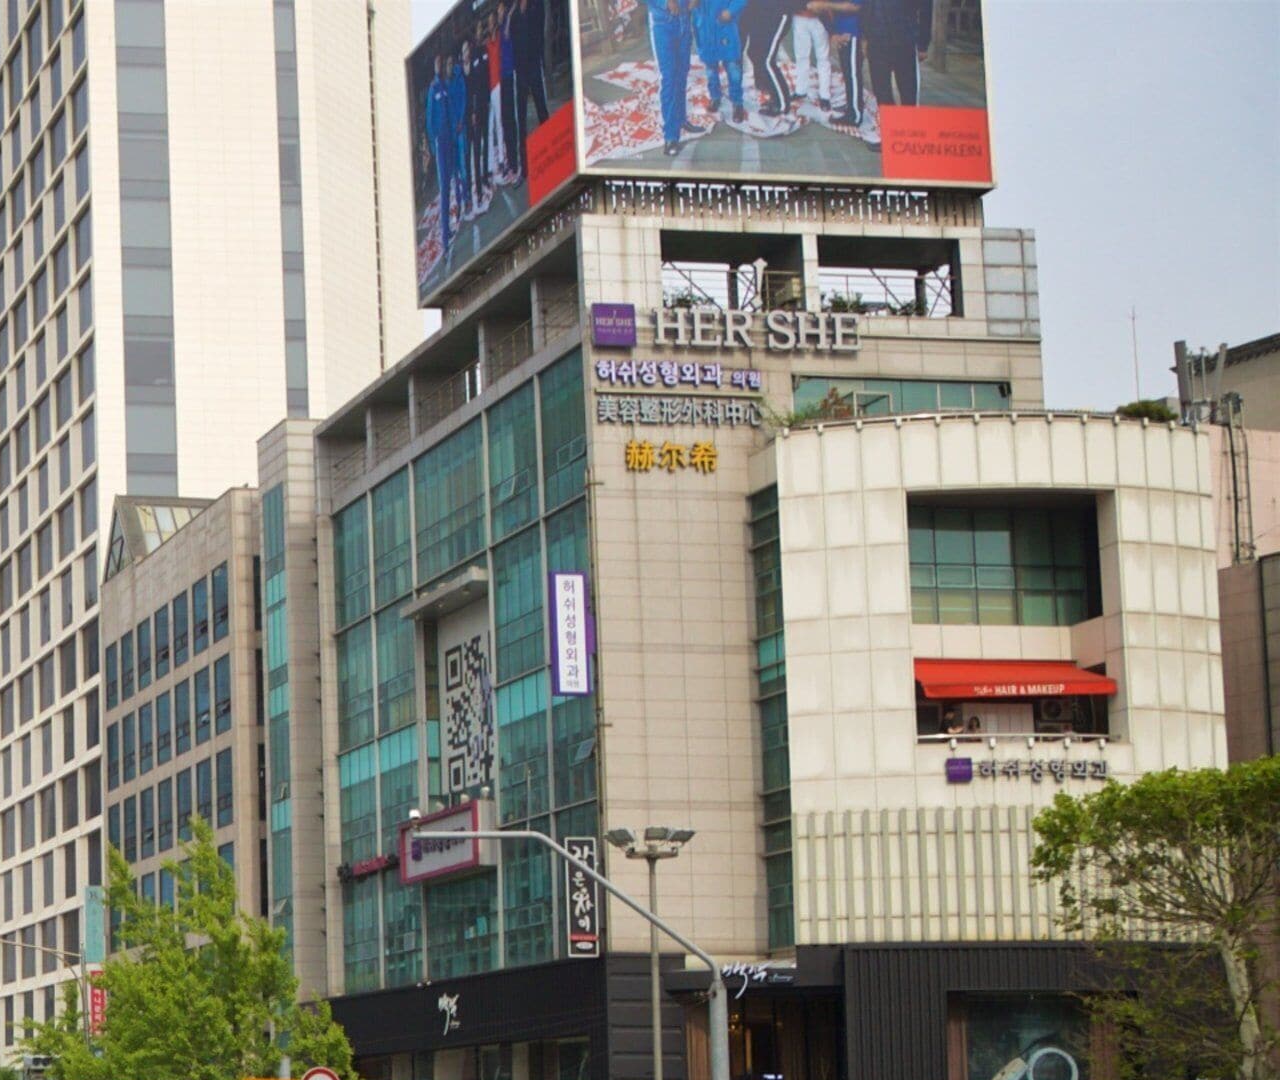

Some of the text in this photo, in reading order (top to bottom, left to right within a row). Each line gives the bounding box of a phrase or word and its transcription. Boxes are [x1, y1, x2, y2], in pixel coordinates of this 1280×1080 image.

[891, 141, 983, 158] CALVIN KLEIN
[653, 307, 862, 352] HER SHE
[596, 360, 762, 388] 허쉬성형외과 의원
[598, 395, 762, 427] 美容整形外科中心
[625, 440, 719, 473] 赫尔希
[563, 579, 580, 679] 허쉬성형외과
[994, 684, 1017, 695] HAIR
[1027, 683, 1065, 694] MAKEUP
[979, 759, 1109, 783] 허쉬성형외과
